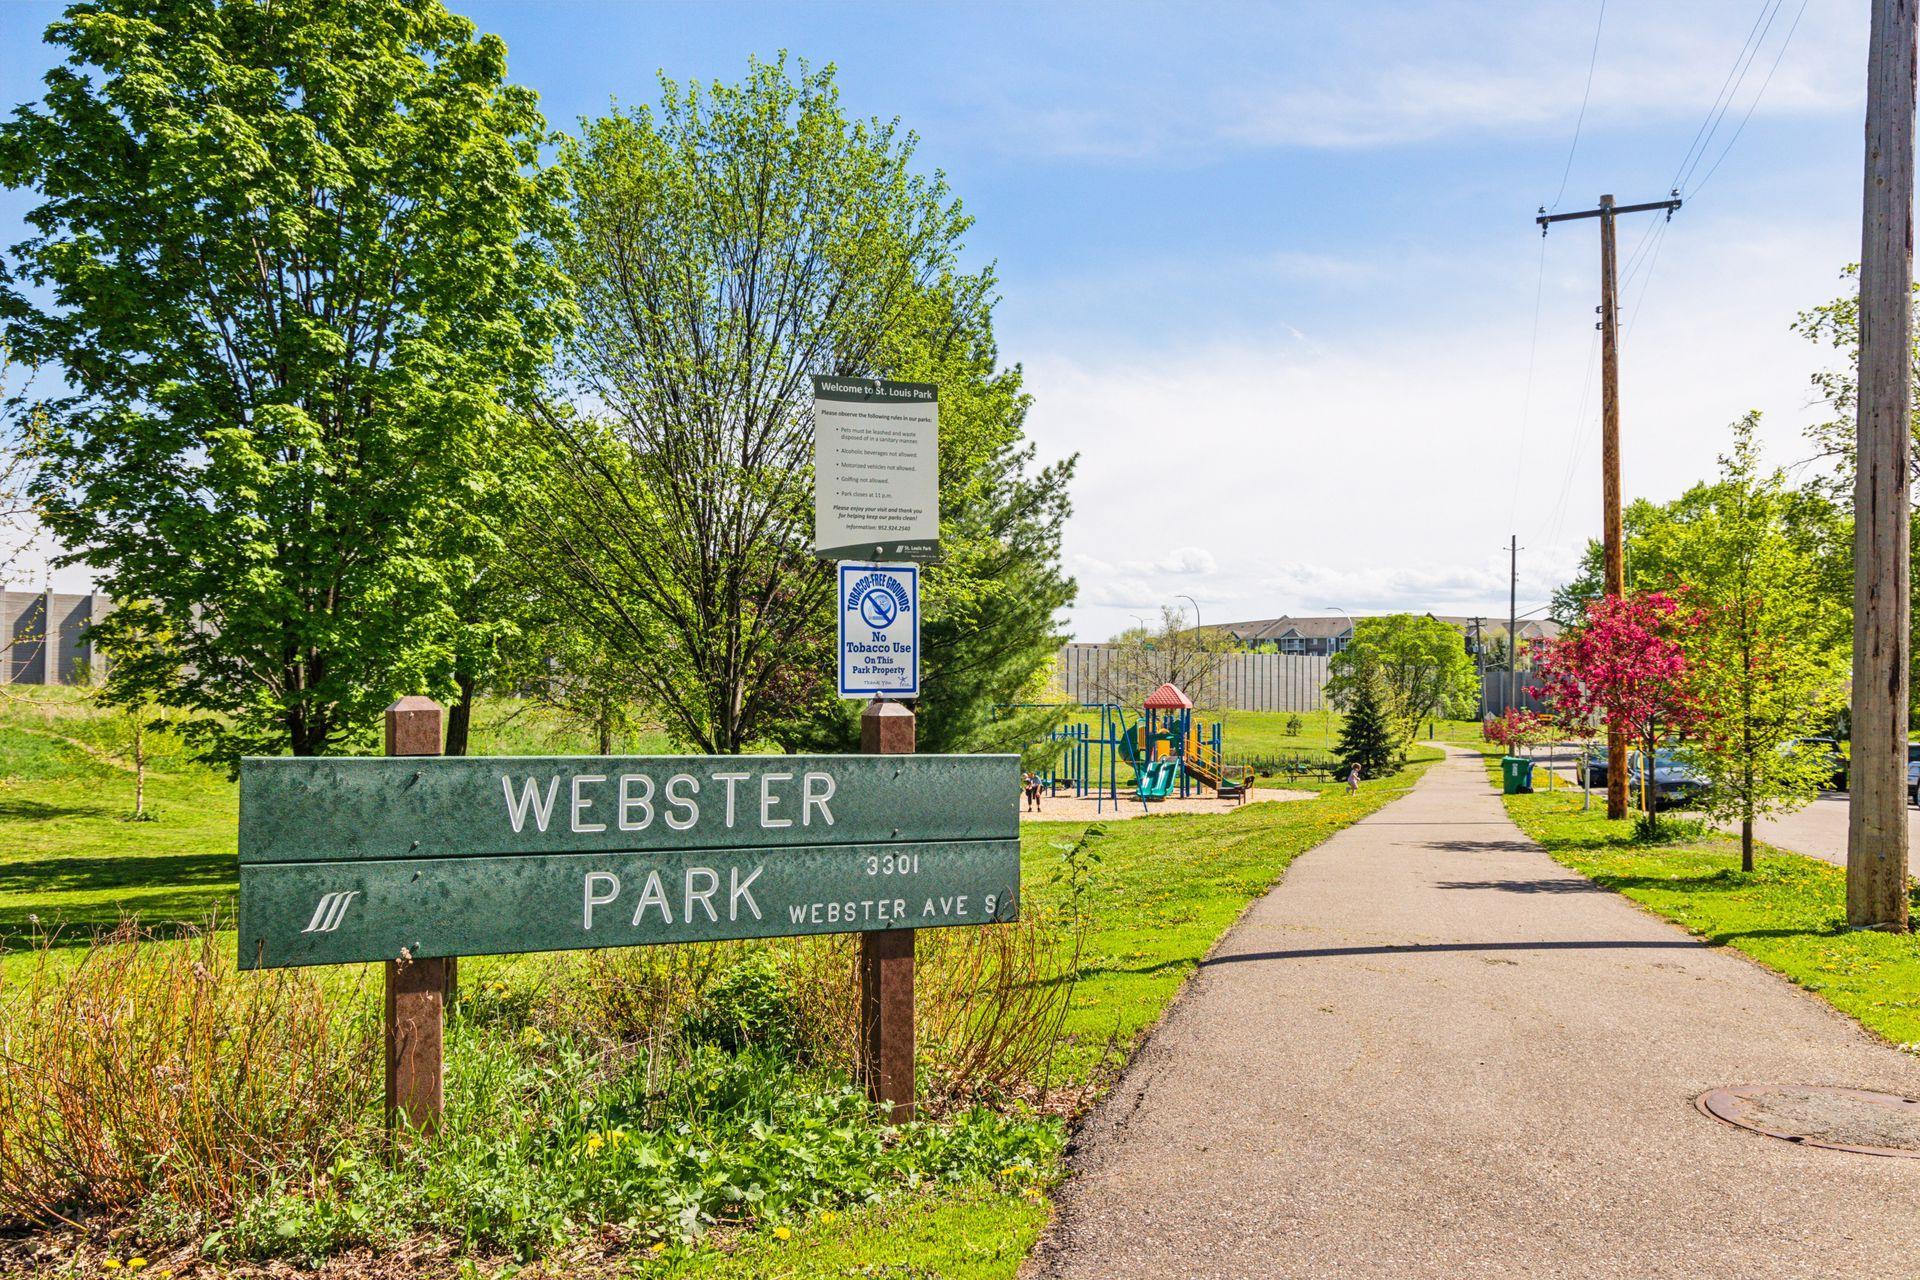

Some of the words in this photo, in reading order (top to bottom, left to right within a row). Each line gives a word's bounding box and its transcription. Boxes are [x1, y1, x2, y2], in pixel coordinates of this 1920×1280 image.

[822, 381, 862, 394] Welcome
[864, 386, 874, 395] to
[875, 386, 887, 396] St.
[890, 388, 912, 398] Louis
[913, 390, 932, 400] Park
[868, 412, 890, 420] following
[864, 449, 888, 457] beverages
[841, 476, 858, 484] Golfing
[848, 573, 887, 612] TOBACCO-FREE
[886, 576, 910, 612] GROUNDS
[872, 632, 886, 642] No
[846, 642, 890, 652] Tobacco
[893, 642, 912, 652] Use
[852, 666, 870, 674] Park
[872, 666, 906, 676] Property
[501, 771, 837, 834] WEBSTER
[866, 854, 919, 876] 3301
[583, 864, 764, 931] PARK
[788, 898, 906, 924] WEBSTER
[922, 895, 968, 917] AVE
[984, 894, 997, 914] S
